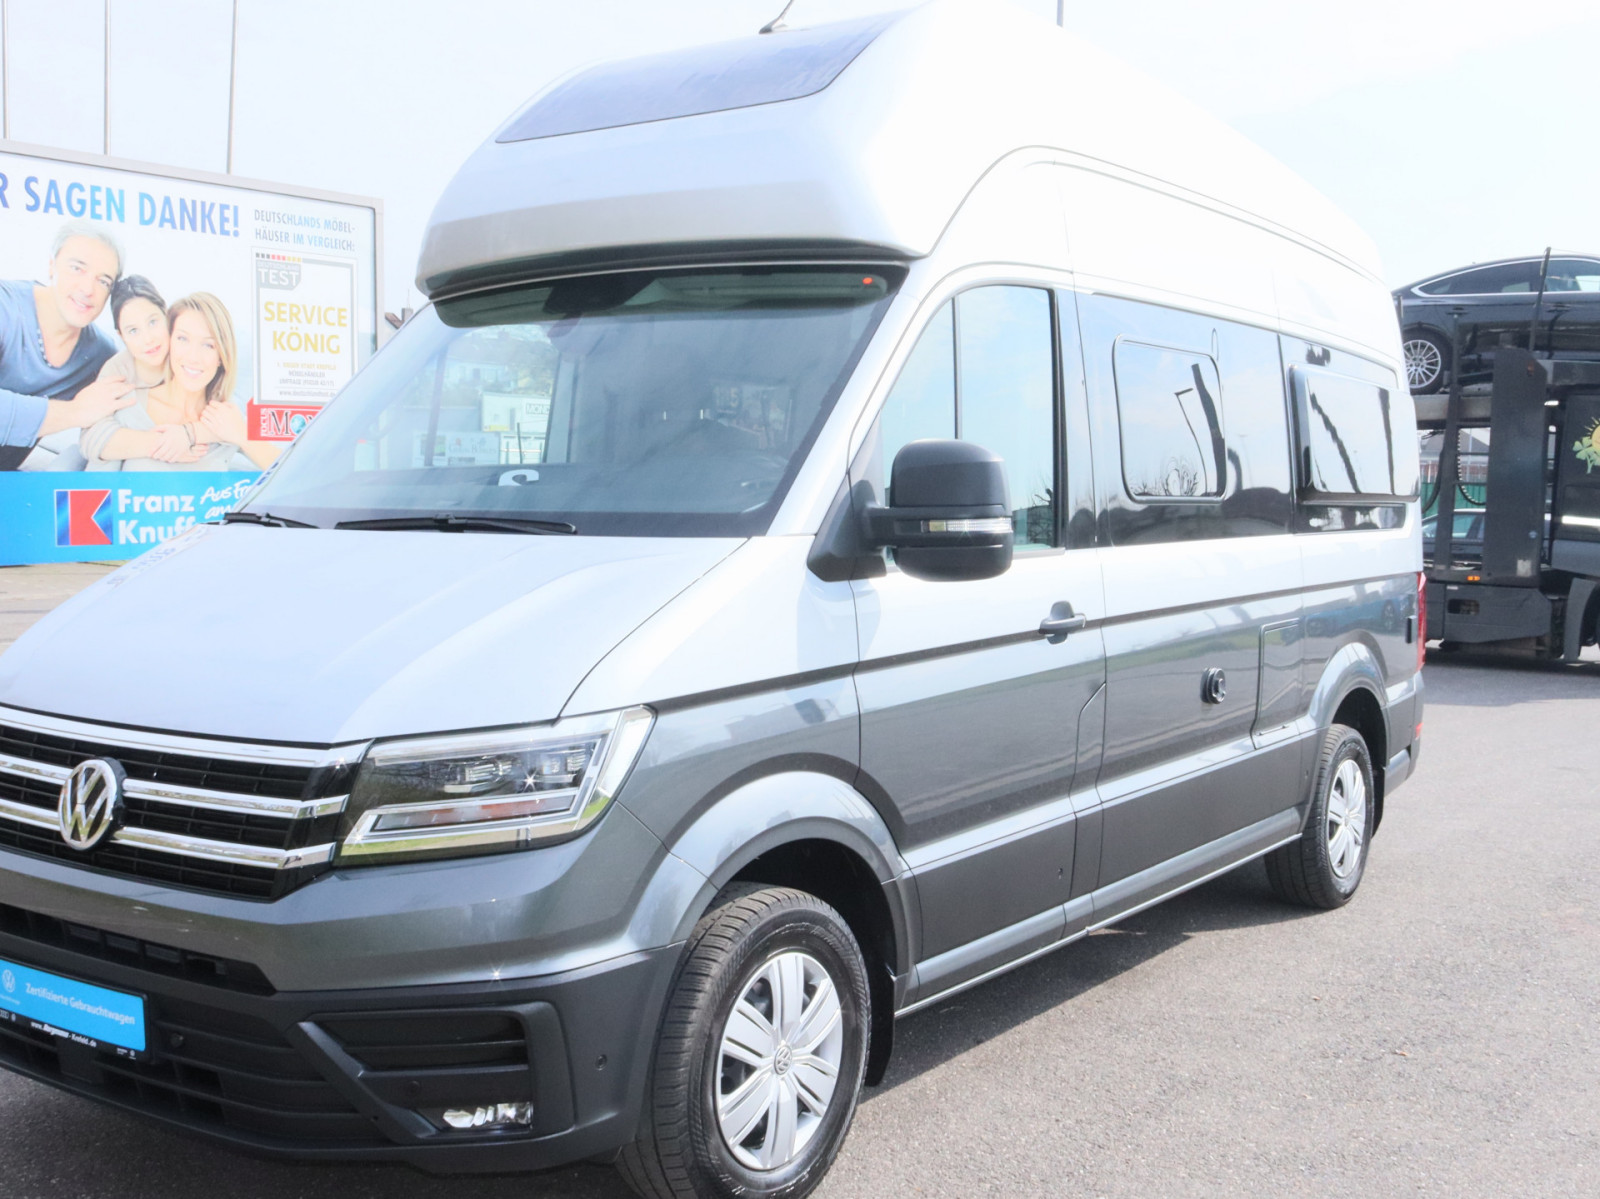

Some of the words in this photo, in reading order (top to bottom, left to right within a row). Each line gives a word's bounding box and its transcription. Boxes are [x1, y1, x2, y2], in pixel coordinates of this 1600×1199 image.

[24, 176, 125, 223] SAGEN
[138, 191, 240, 238] DANKE!
[254, 209, 321, 229] DEUTSCHLANDS
[324, 216, 355, 233] MÖBEL-
[255, 226, 290, 243] HÄUSER
[293, 232, 304, 245] IM
[307, 234, 355, 252] VERGLEICH:
[258, 267, 299, 287] TEST
[263, 301, 348, 328] SERVICE
[272, 326, 341, 355] KÖNIG
[118, 489, 195, 513] Franz
[200, 486, 232, 504] Aus
[25, 982, 69, 1006] Zertifizierte
[69, 997, 136, 1025] Gebrauchtwagen
